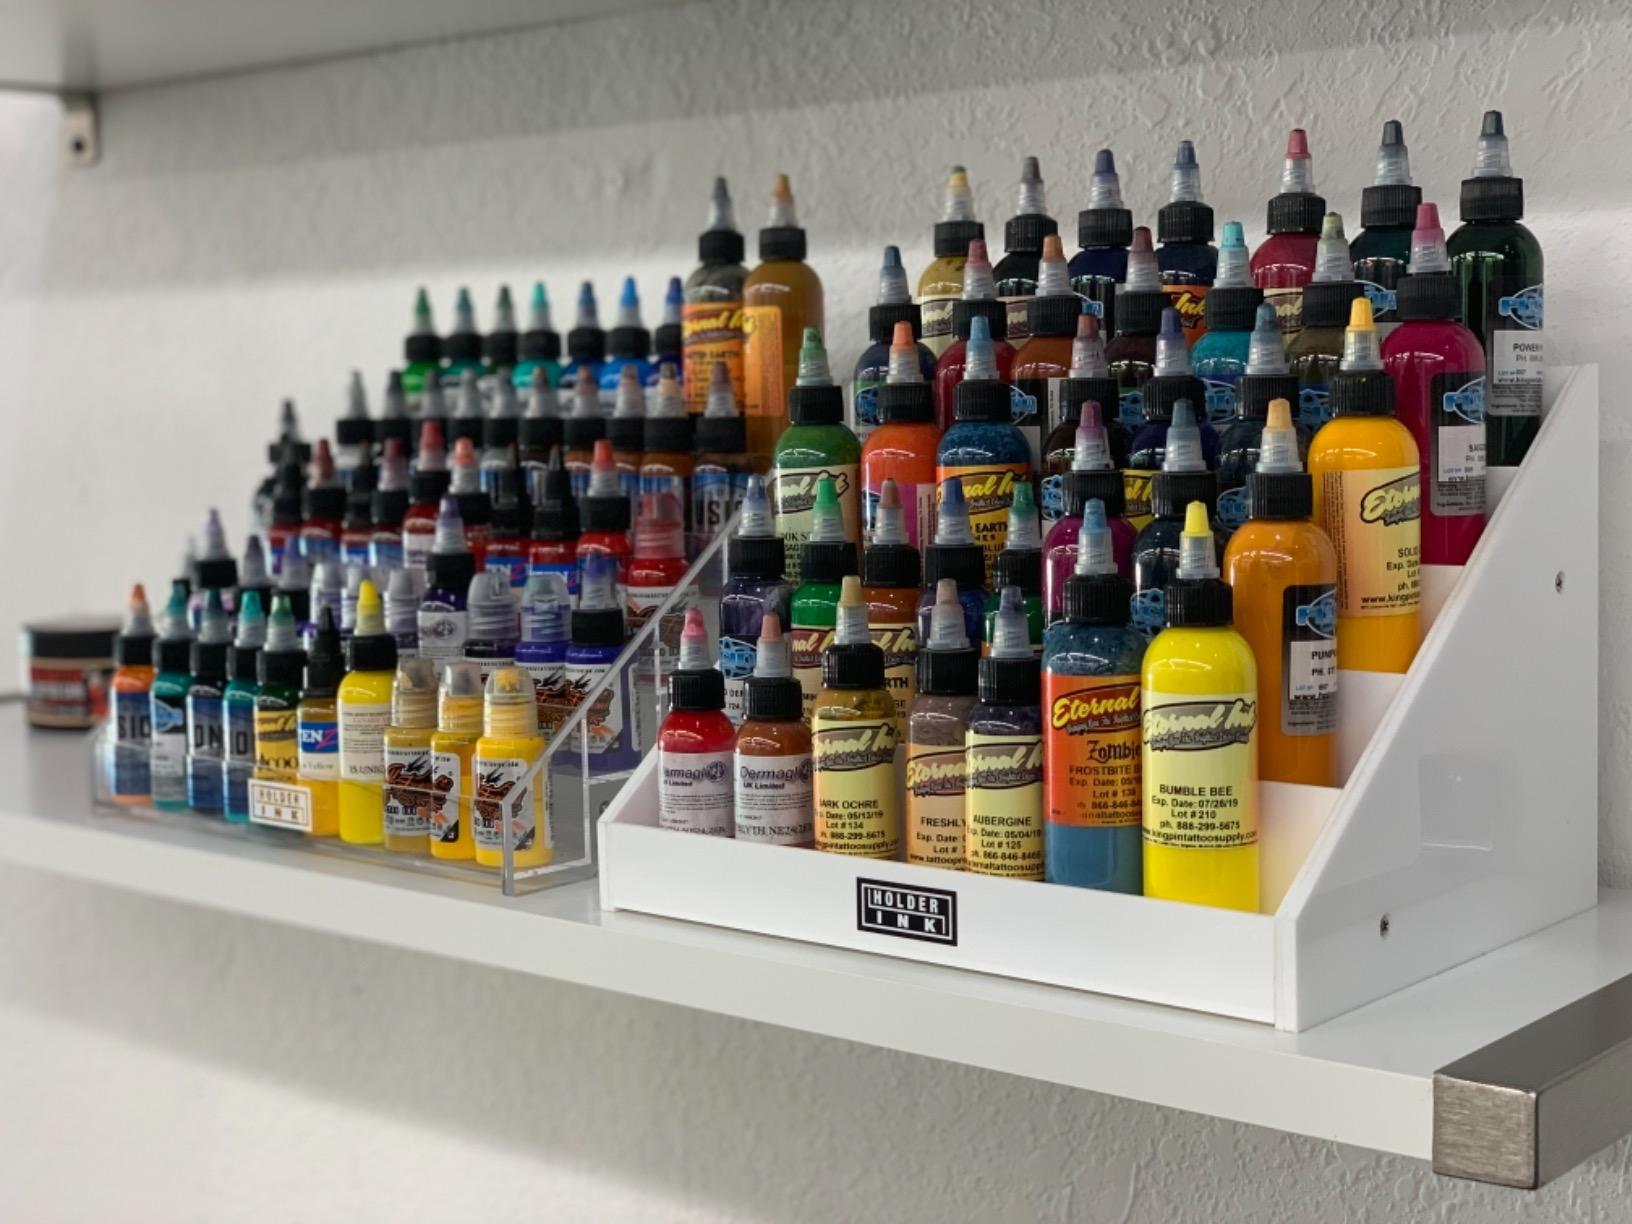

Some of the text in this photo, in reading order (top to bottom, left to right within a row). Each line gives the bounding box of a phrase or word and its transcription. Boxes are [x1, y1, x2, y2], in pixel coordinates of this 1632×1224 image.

[1053, 686, 1139, 727] Eternal
[1069, 765, 1131, 775] FROSTBITE
[743, 782, 753, 790] UK
[1159, 783, 1233, 796] BUMBLE BEE
[1093, 790, 1109, 798] Lot
[841, 800, 879, 809] OCHRE
[1151, 795, 1168, 806] Exp.
[1171, 798, 1197, 808] Date:
[825, 810, 846, 820] Date:
[1171, 808, 1217, 819] Lot # 210
[825, 820, 839, 829] Lot
[973, 815, 1032, 826] AUBERGINE
[916, 833, 959, 843] Exp. Date:
[981, 828, 1004, 838] Date:
[981, 840, 996, 849] Lot
[933, 846, 949, 854] Lot
[872, 889, 939, 914] HOLDER
[876, 910, 936, 932] INK
